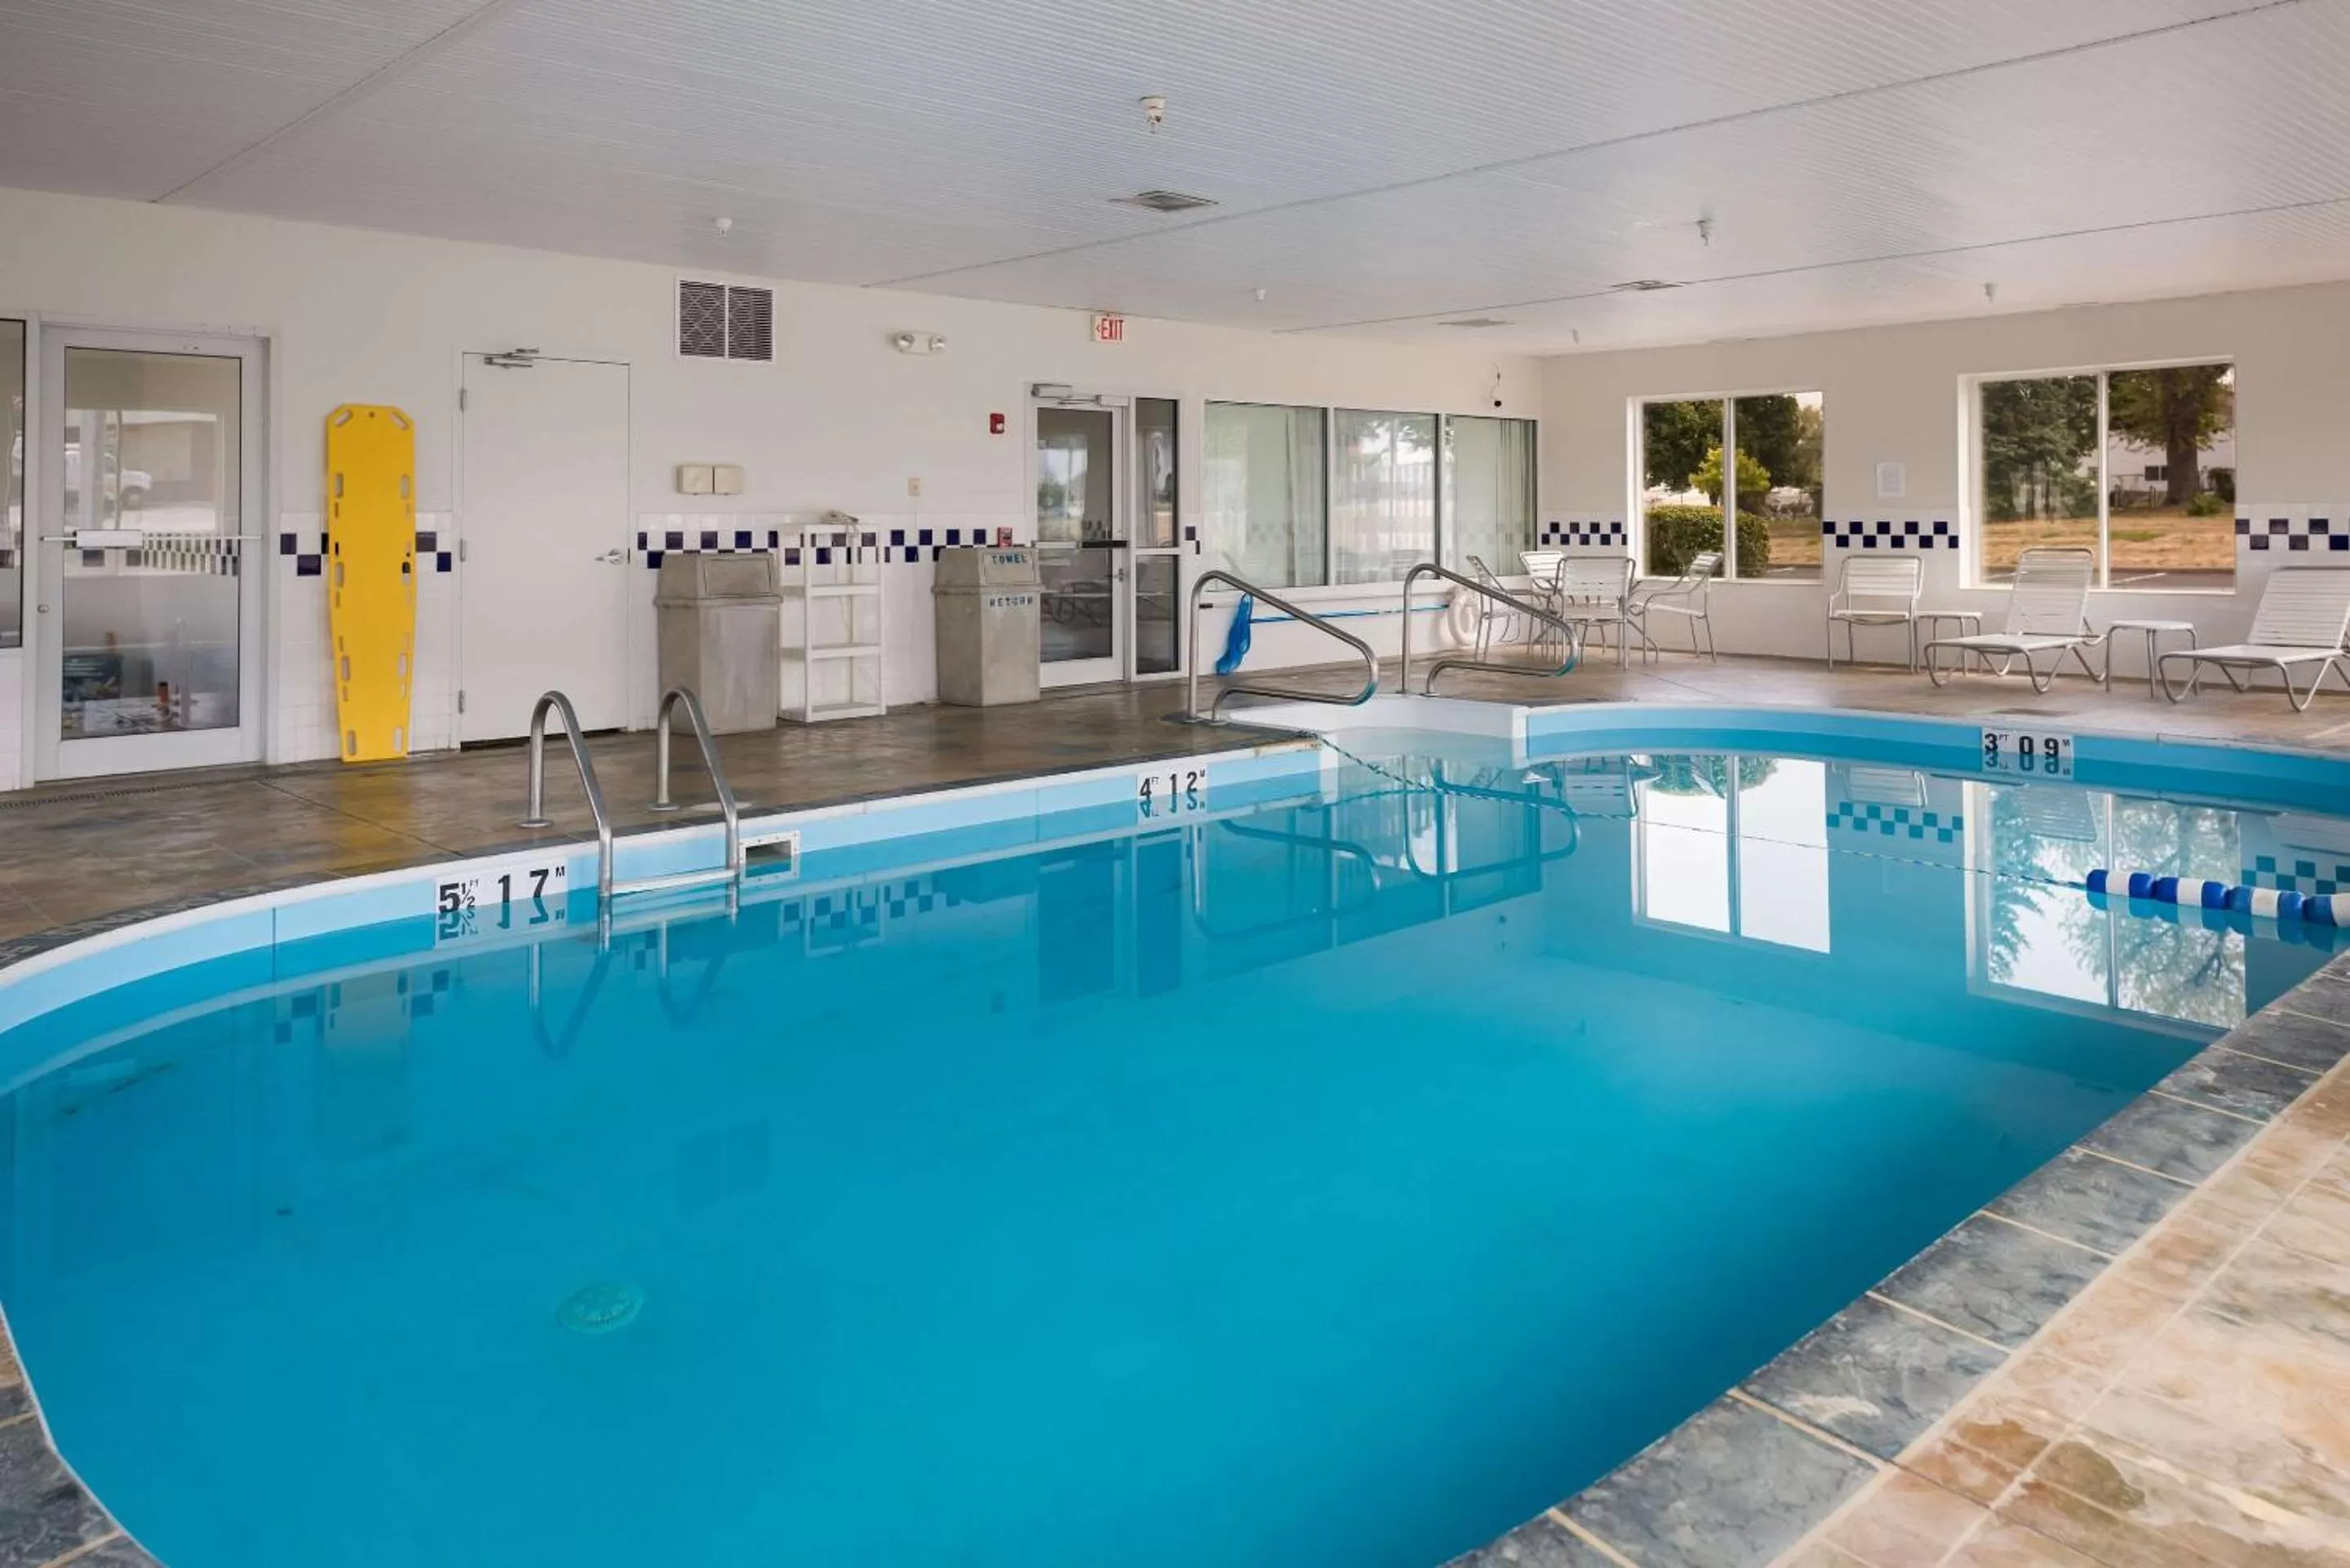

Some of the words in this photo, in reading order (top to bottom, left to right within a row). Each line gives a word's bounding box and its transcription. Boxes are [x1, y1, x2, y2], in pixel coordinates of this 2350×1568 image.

[1102, 318, 1124, 340] EXIT
[992, 554, 1026, 565] TOWEL
[1984, 733, 1998, 751] 3
[1140, 777, 1152, 800] 4
